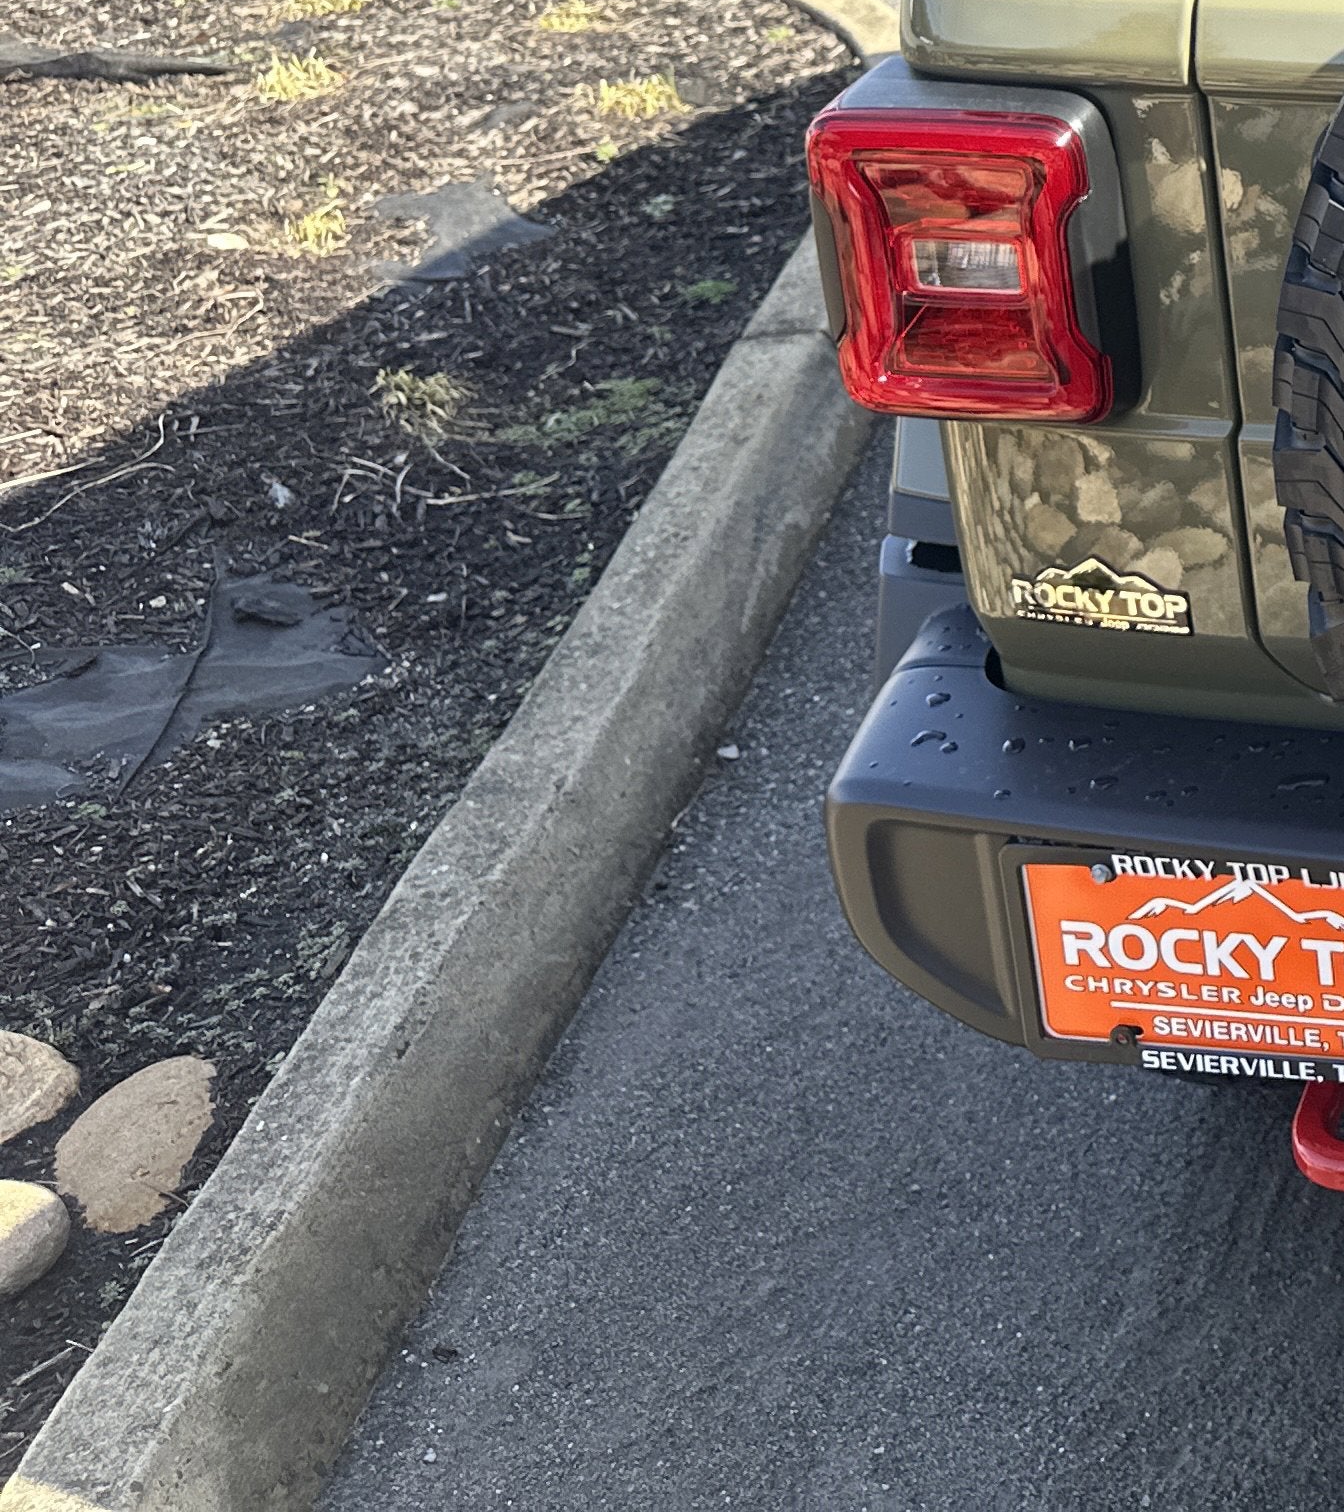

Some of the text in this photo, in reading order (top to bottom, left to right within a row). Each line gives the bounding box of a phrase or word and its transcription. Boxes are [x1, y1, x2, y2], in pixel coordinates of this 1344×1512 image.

[1012, 578, 1189, 619] ROCKY TOP
[1111, 853, 1215, 881] ROCKY
[1226, 861, 1290, 885] TOP
[1060, 920, 1290, 982] ROCKY
[1063, 973, 1242, 1005] CHRYSLER
[1250, 985, 1314, 1014] Jeep
[1153, 1015, 1330, 1052] SEVIERVILLE,
[1141, 1048, 1325, 1083] SEVIERVILLE,
